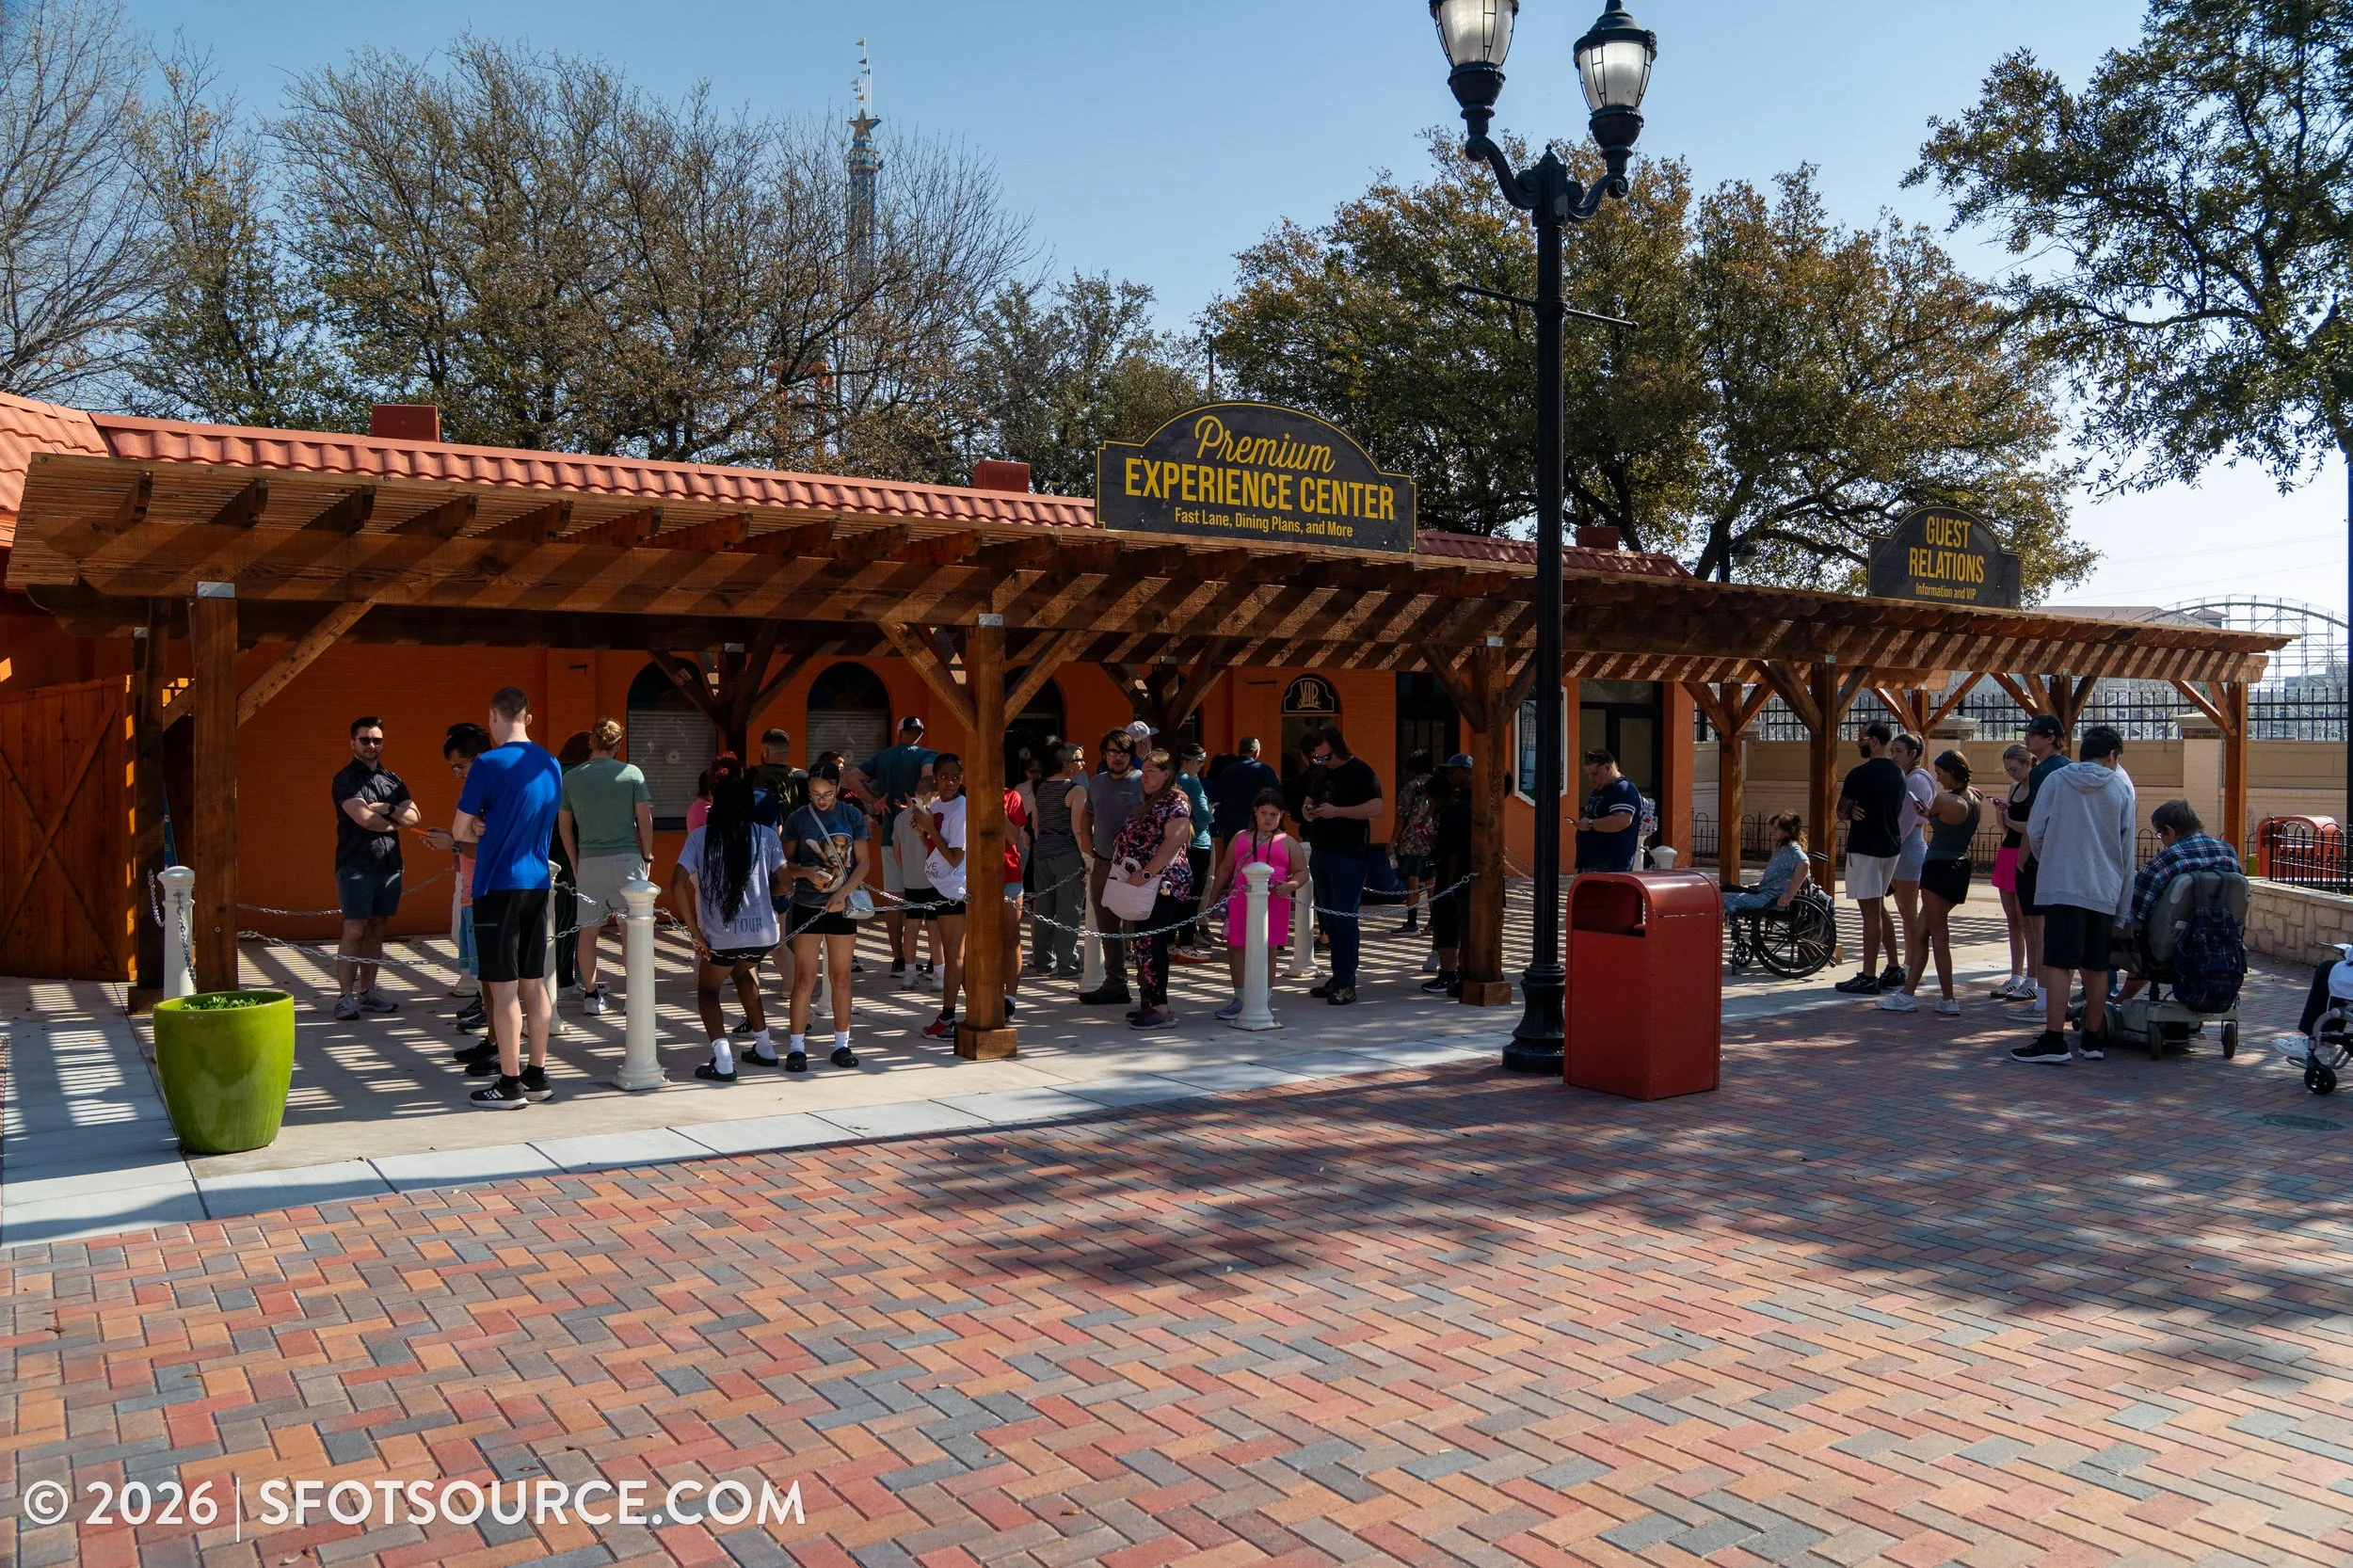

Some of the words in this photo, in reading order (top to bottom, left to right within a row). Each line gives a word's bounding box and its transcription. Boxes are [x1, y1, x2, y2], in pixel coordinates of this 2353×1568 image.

[1194, 415, 1336, 473] Premium
[1126, 457, 1292, 510] EXPERIENCE
[1300, 476, 1394, 520] CENTER
[1175, 507, 1200, 524] Fast
[1202, 509, 1232, 529] Lane,
[1235, 512, 1270, 533] Dining
[1272, 516, 1304, 535] Plans,
[1305, 520, 1325, 535] and
[1327, 521, 1353, 537] More
[1926, 515, 1971, 550] GUEST
[1909, 547, 1985, 584] RELATIONS
[1915, 583, 1953, 598] Information
[1954, 587, 1965, 599] and
[1966, 587, 1977, 600] VIP
[1299, 681, 1320, 706] VIP
[732, 917, 763, 935] TOUR
